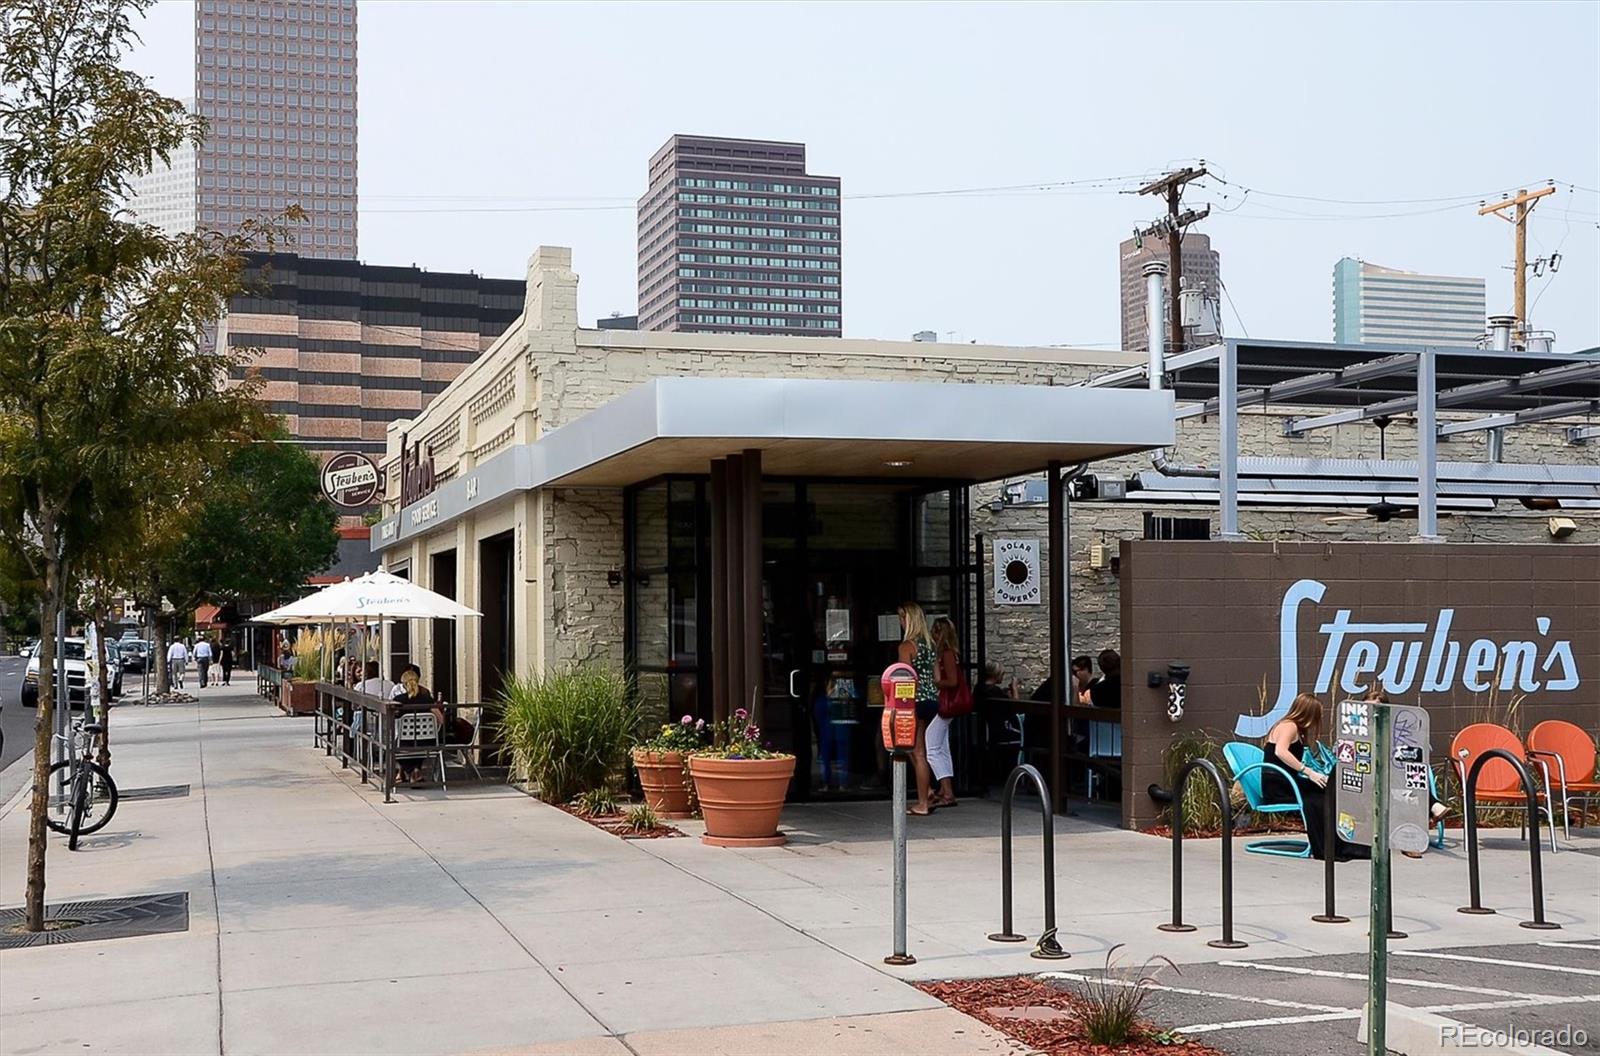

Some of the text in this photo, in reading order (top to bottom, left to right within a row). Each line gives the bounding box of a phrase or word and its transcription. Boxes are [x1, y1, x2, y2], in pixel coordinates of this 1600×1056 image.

[328, 471, 375, 495] Steuben's
[1001, 542, 1032, 553] SOLAR
[997, 587, 1039, 602] POWERED
[1234, 579, 1580, 739] Steuben's
[1341, 703, 1368, 716] INK
[1341, 724, 1368, 736] STR
[1406, 764, 1426, 774] INK
[1406, 781, 1426, 789] STR
